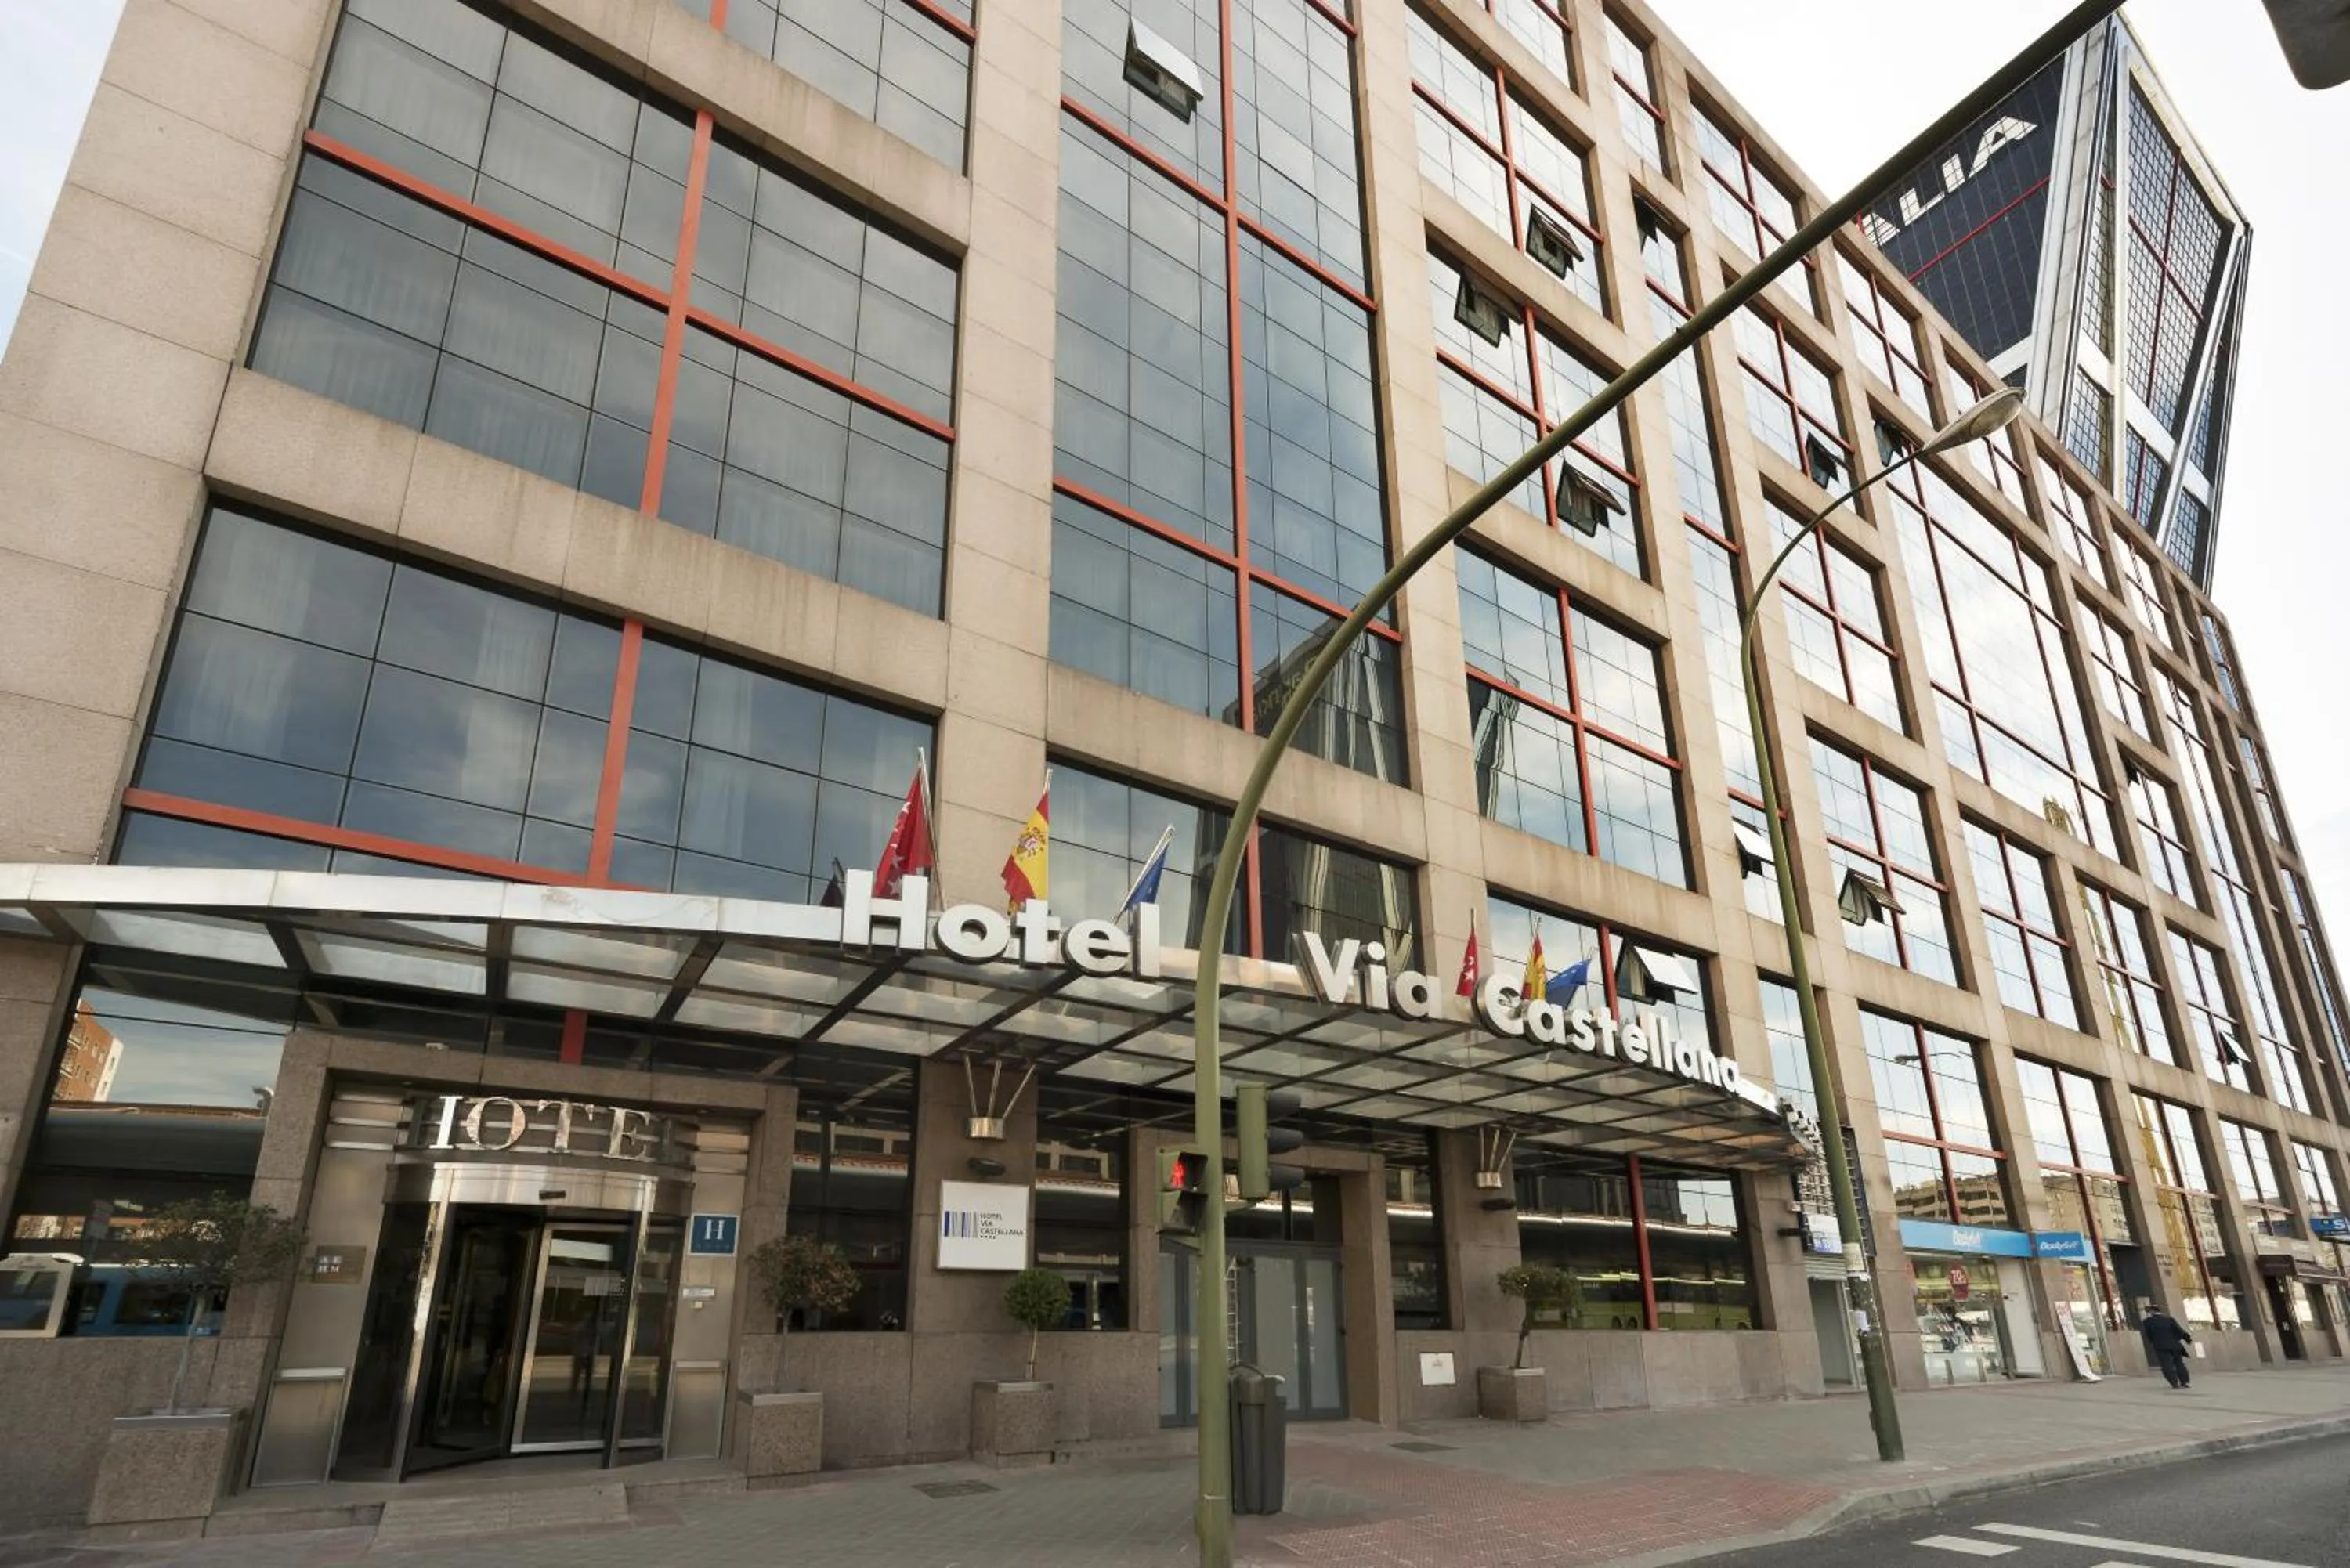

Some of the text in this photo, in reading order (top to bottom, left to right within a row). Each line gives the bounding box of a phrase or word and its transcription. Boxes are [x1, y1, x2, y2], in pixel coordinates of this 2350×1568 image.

[841, 869, 1740, 1093] Hotel Via Castellana
[704, 1219, 725, 1240] H
